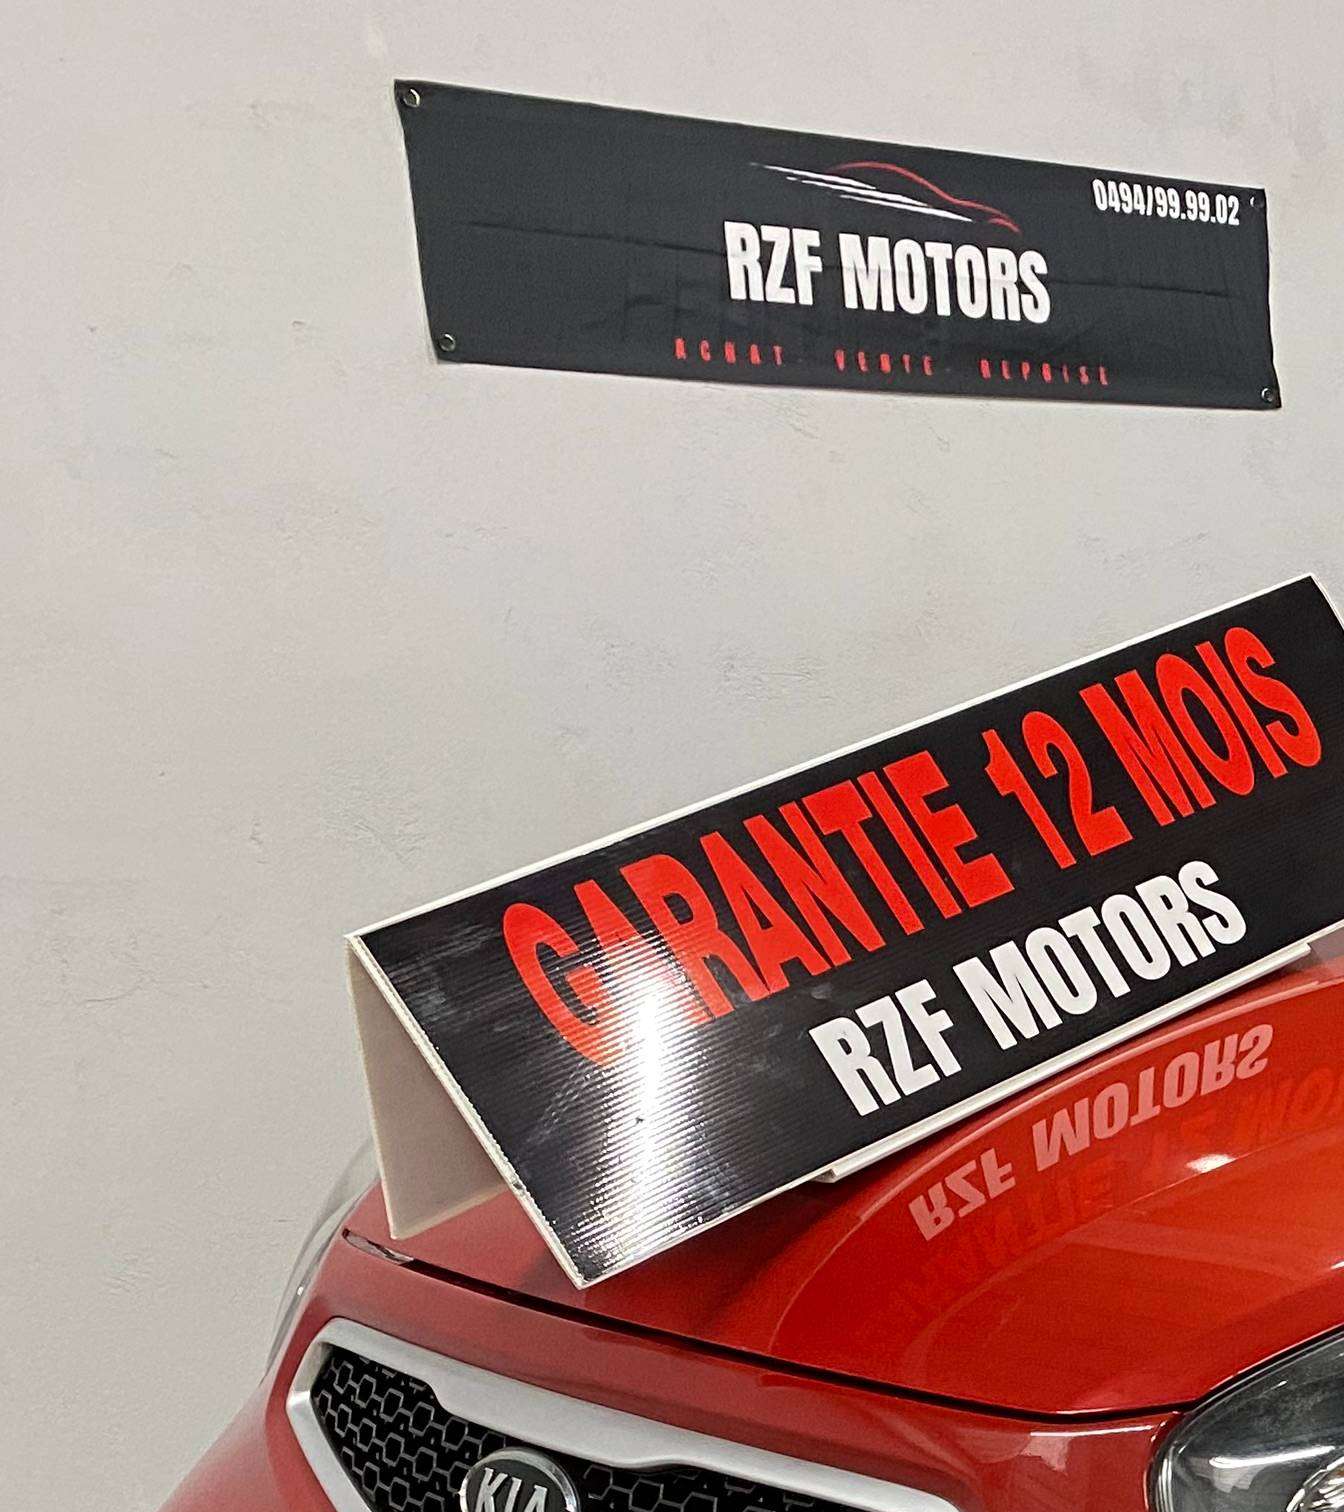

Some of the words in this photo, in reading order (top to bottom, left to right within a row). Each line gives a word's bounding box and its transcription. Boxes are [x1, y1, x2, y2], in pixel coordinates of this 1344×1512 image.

[1092, 178, 1240, 226] 0494/99.99.02
[724, 221, 823, 305] RZF
[839, 232, 1051, 324] MOTORS
[674, 337, 782, 366] ACHAT
[502, 750, 1014, 1066] GARANTIE
[983, 710, 1133, 870] 12
[1080, 626, 1323, 826] MOIS
[808, 976, 961, 1117] RZF
[974, 860, 1247, 1051] MOTORS
